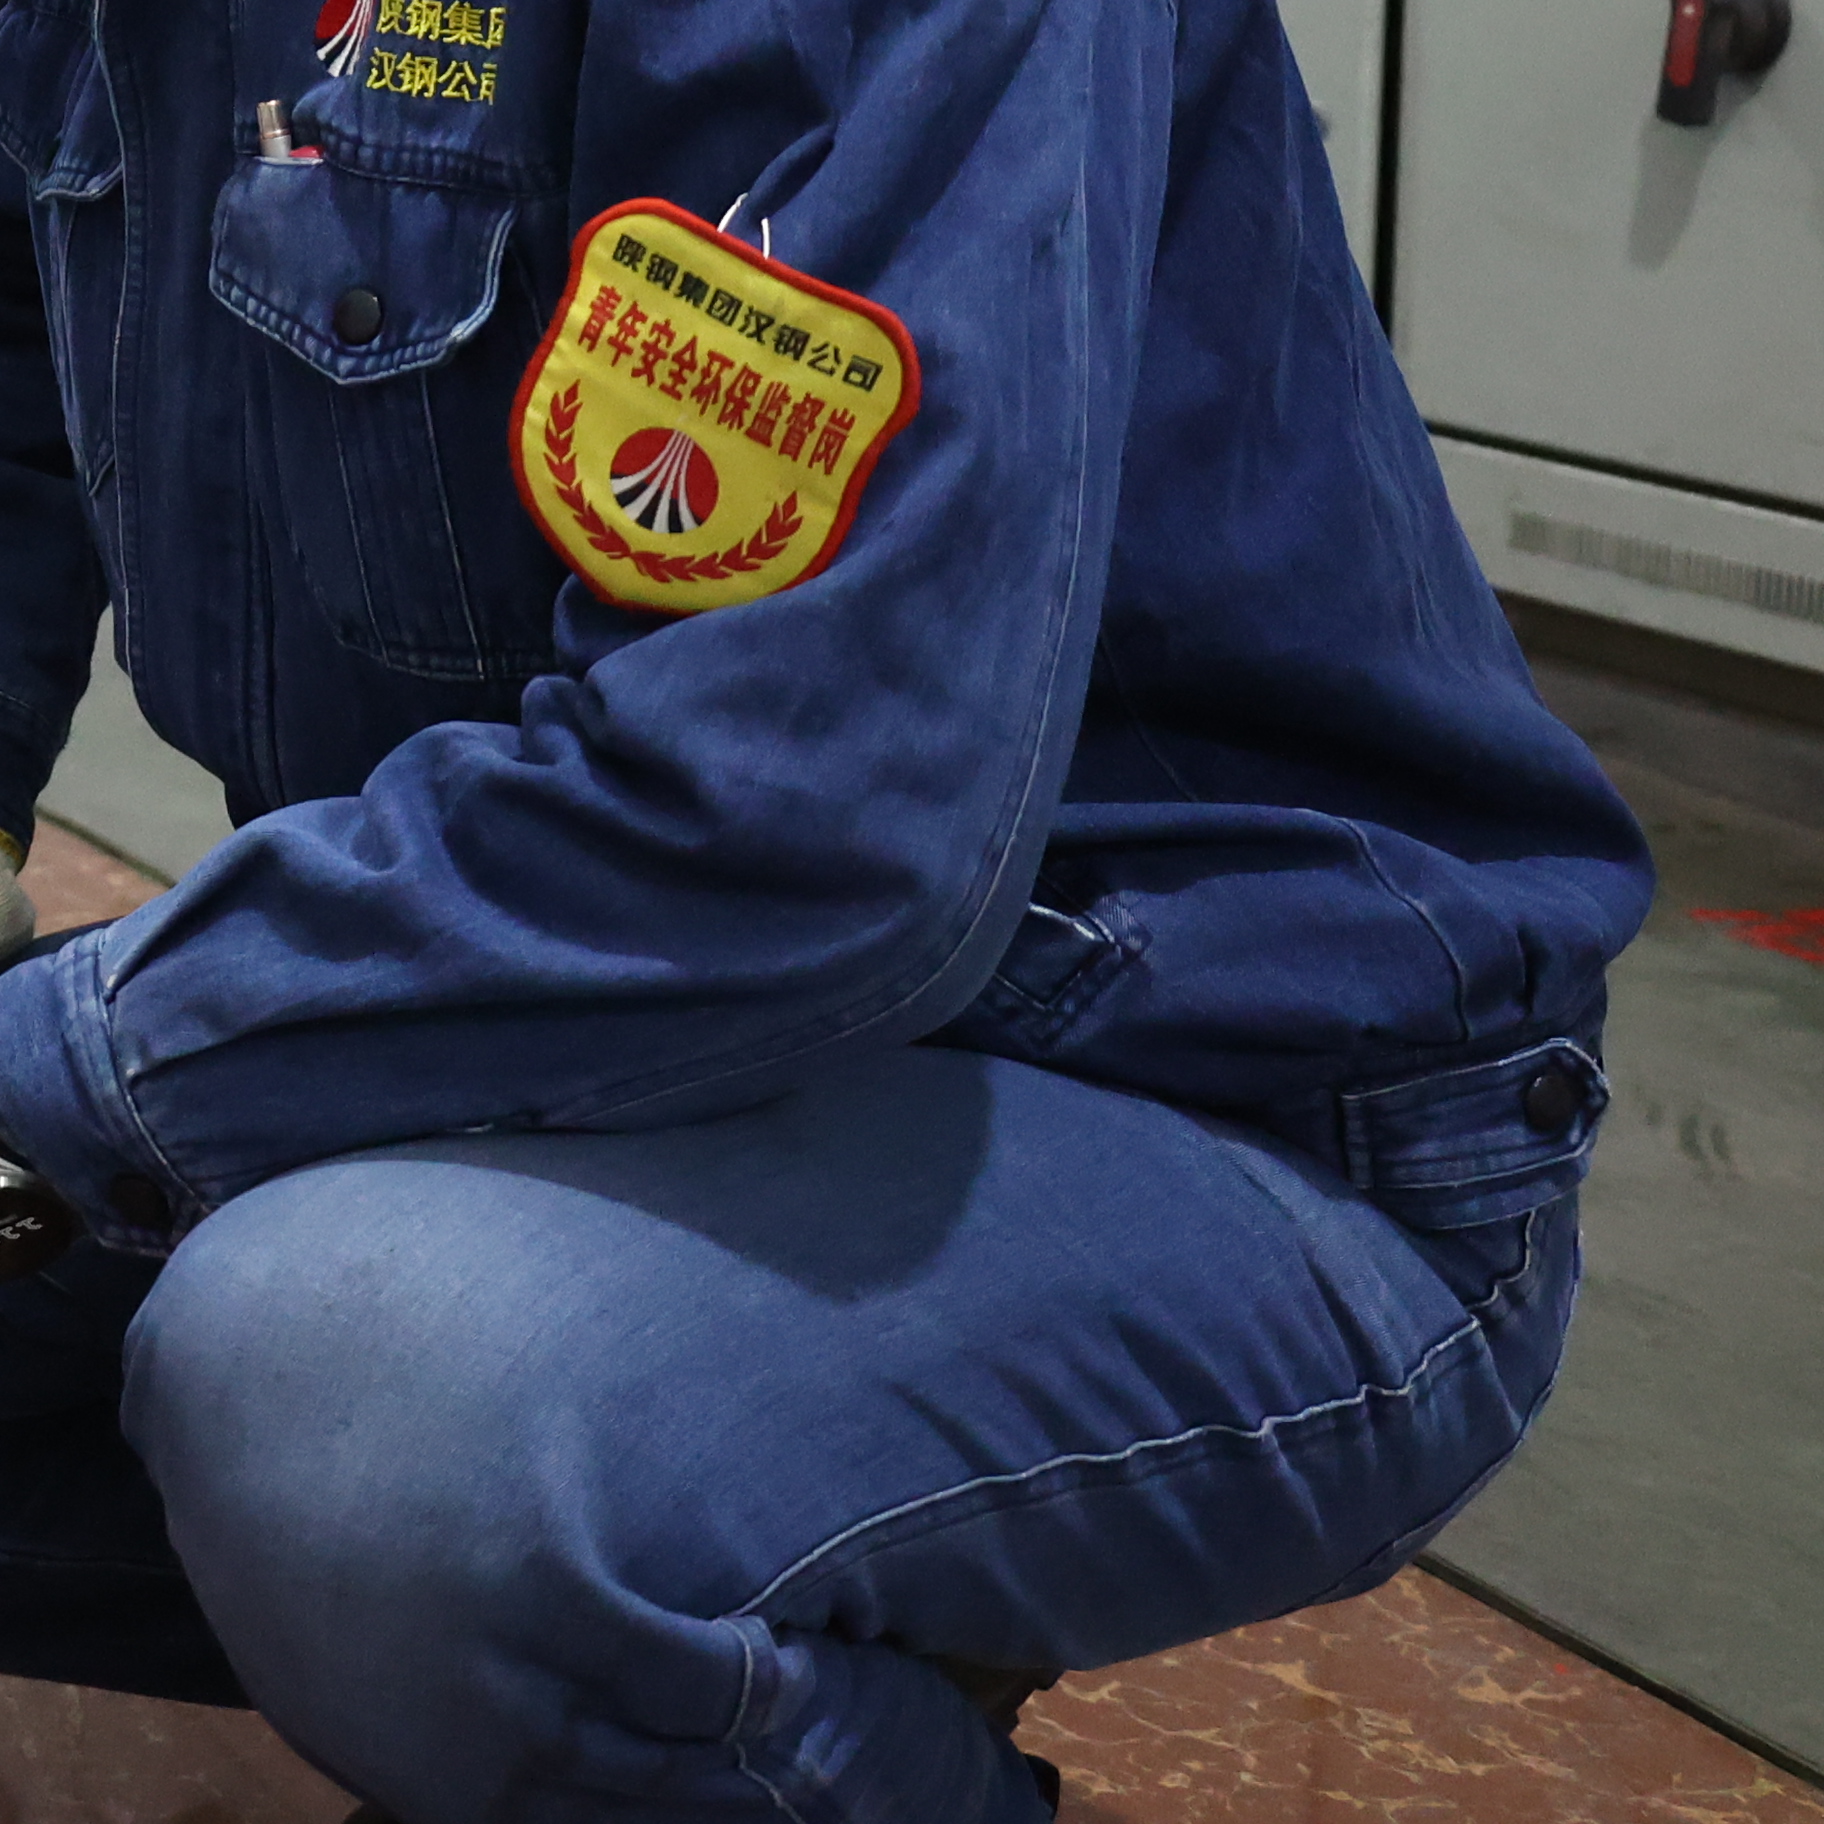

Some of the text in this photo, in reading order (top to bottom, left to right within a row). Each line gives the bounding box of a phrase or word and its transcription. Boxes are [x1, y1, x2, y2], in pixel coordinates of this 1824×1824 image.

[577, 284, 857, 476] 青年安全环保监督岗
[612, 233, 884, 393] 陕钢集团汉钢公司
